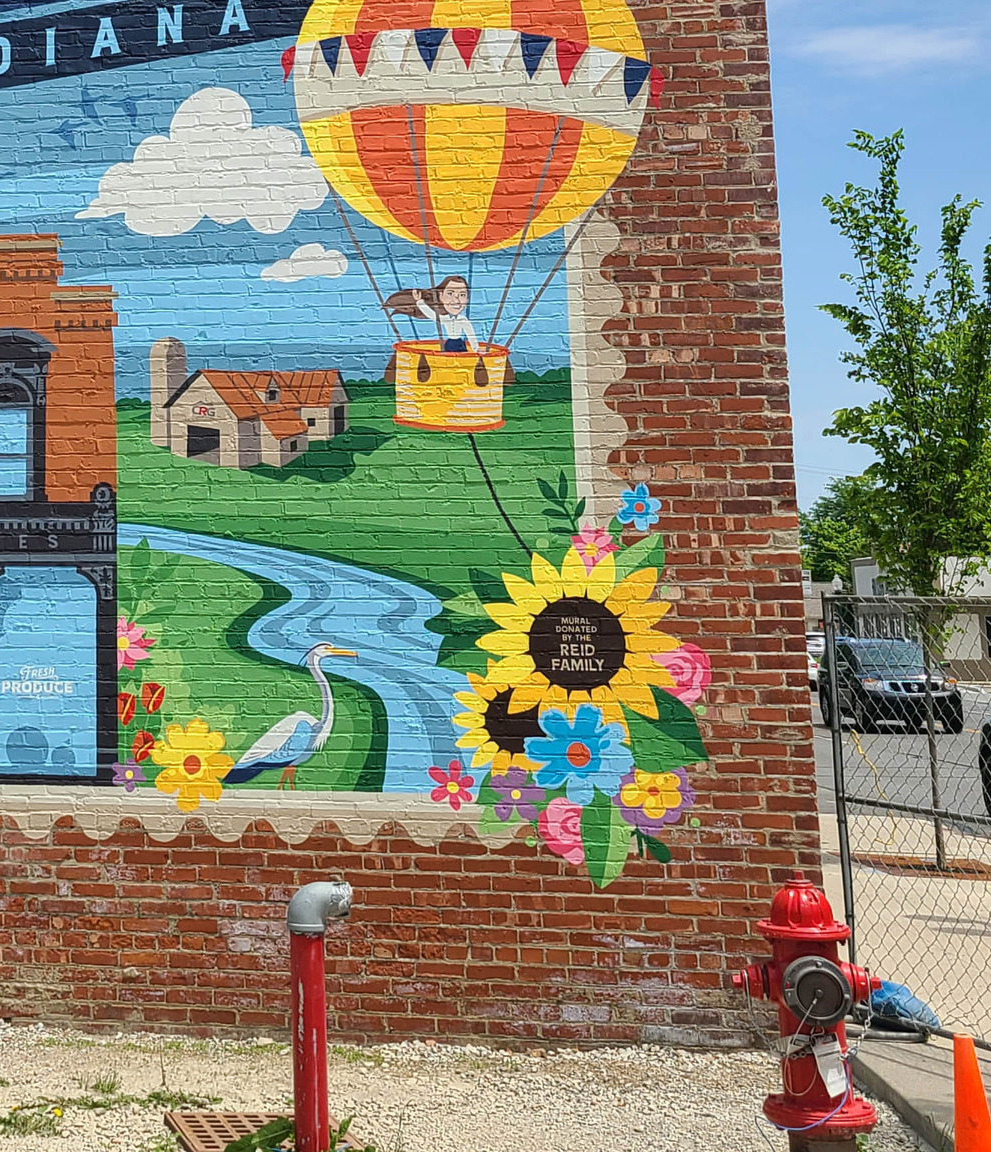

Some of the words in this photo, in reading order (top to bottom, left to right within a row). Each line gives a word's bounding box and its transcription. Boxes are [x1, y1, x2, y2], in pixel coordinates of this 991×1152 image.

[561, 617, 591, 625] MURAL
[555, 625, 598, 633] DONATED
[562, 634, 572, 642] BY
[575, 634, 592, 642] THE
[560, 643, 595, 656] REID
[551, 658, 605, 672] FAMILY
[1, 680, 73, 694] PRODUCE
